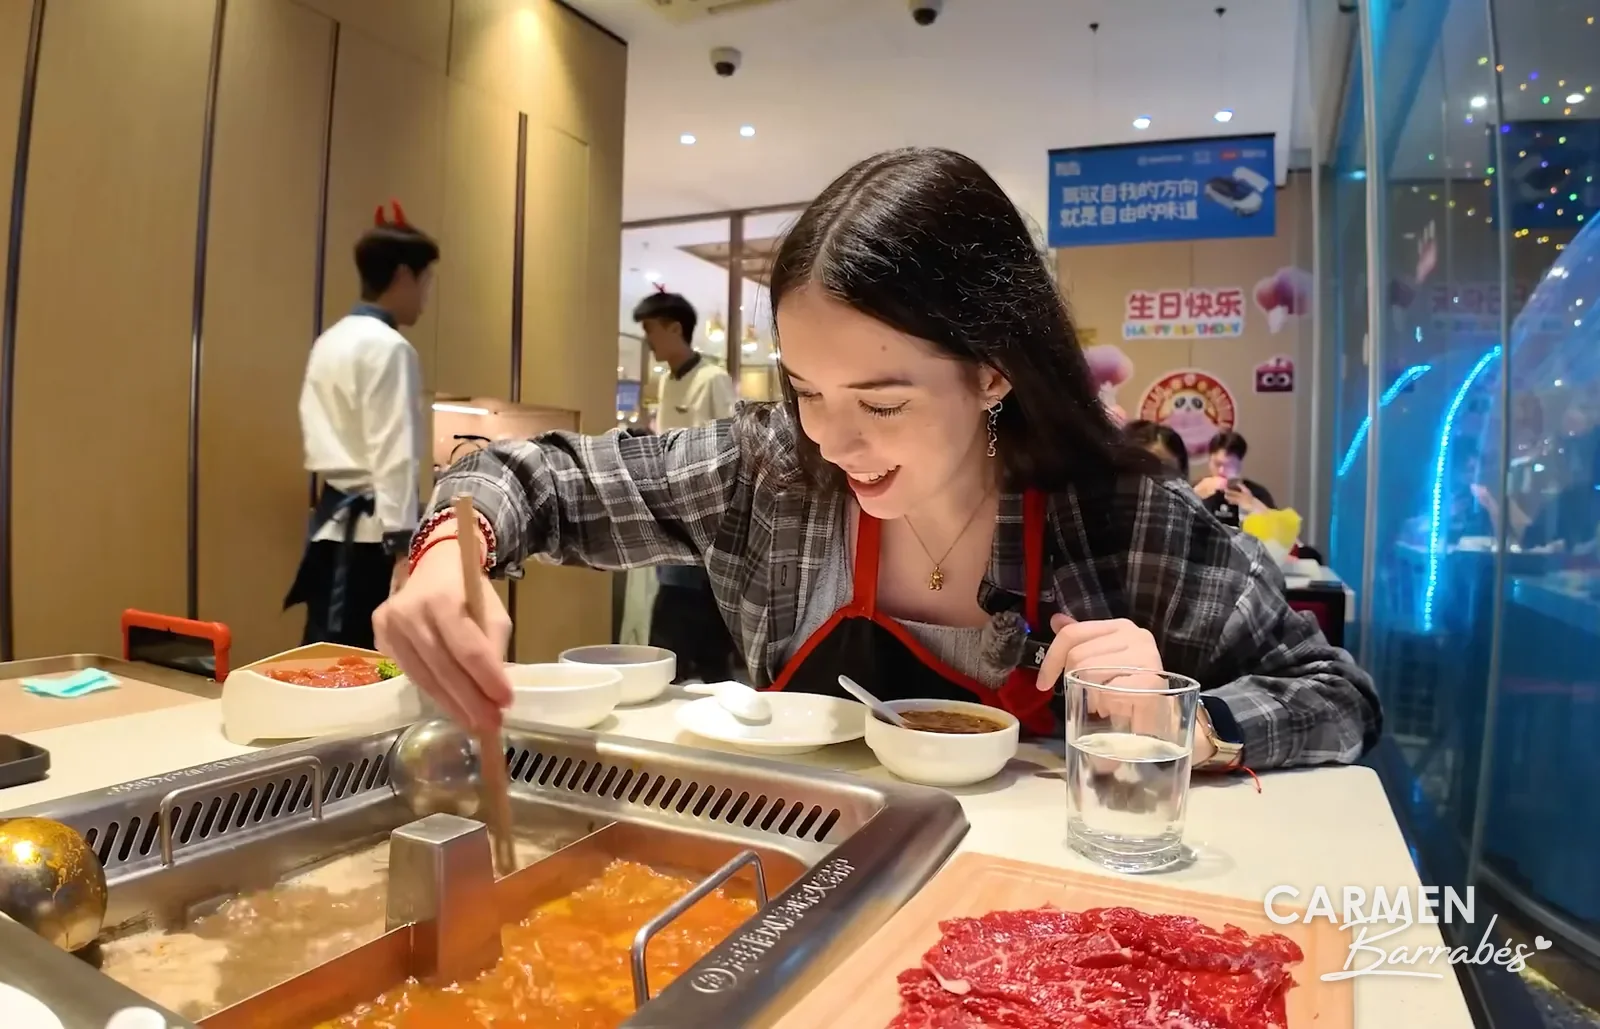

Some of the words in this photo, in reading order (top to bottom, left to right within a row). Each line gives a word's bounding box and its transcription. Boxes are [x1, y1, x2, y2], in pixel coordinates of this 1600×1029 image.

[1060, 201, 1198, 227] 就是自由的味道
[1128, 291, 1242, 320] 生日快乐
